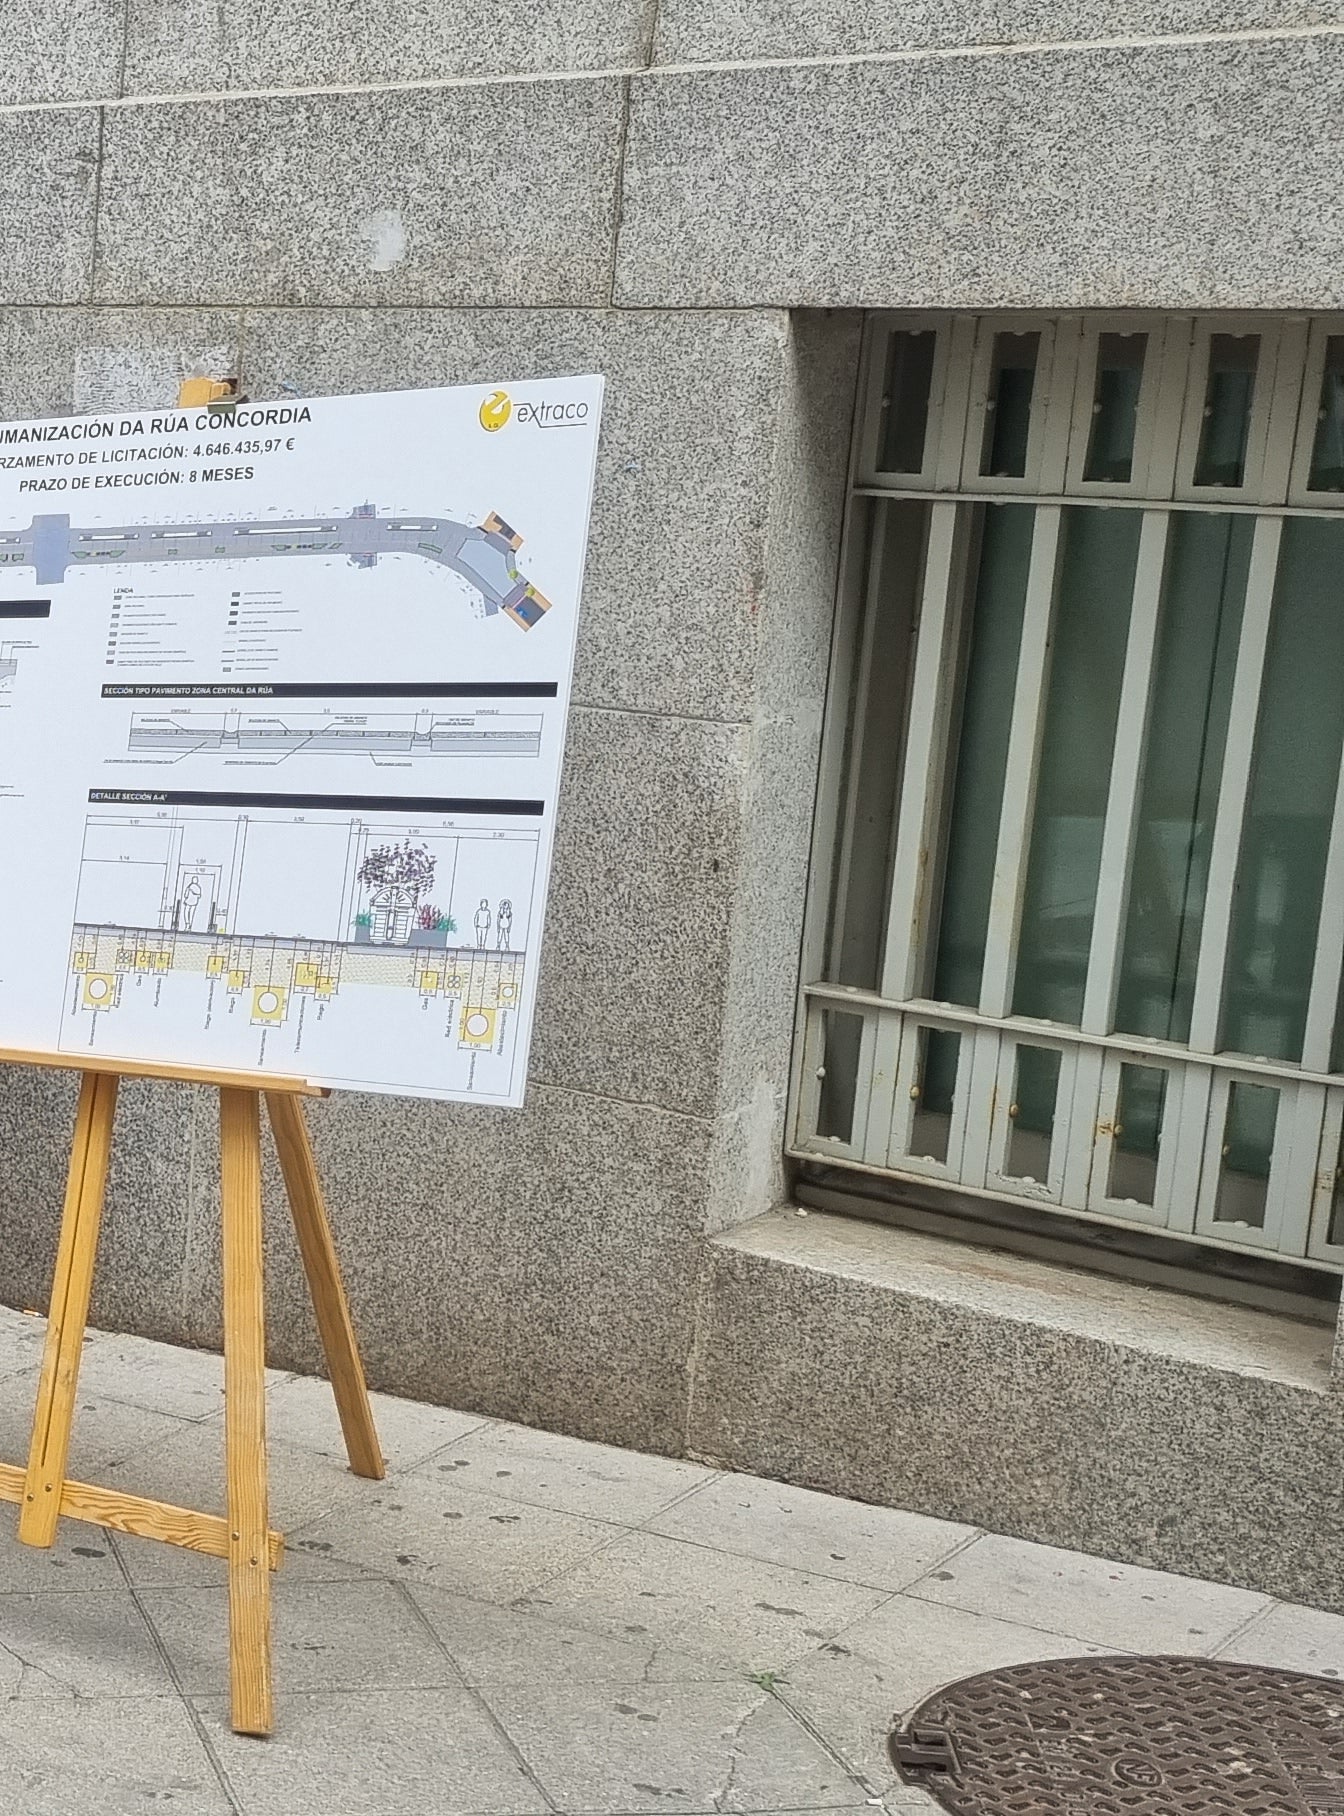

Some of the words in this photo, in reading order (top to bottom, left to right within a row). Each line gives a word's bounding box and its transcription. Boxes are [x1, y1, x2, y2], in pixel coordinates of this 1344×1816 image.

[119, 420, 145, 436] DA
[150, 413, 189, 434] RÚA
[195, 406, 312, 431] CONCORDIA
[515, 400, 589, 425] extraco
[78, 451, 98, 465] DE
[101, 443, 189, 463] LICITACIÓN:
[192, 438, 282, 458] 4.646.435,97
[286, 437, 296, 451] €
[19, 478, 67, 493] PRAZO
[71, 476, 91, 490] DE
[95, 469, 185, 489] EXECUCIÓN:
[189, 471, 197, 483] 8
[201, 466, 254, 482] MESES
[103, 686, 134, 695] SECCIÓN
[135, 687, 151, 695] TIPO
[151, 687, 191, 695] PAVIMENTO
[191, 687, 212, 695] ZONA
[258, 685, 274, 694] RÚA
[90, 792, 121, 800] DETALLE
[121, 792, 152, 801] SECCIÓN
